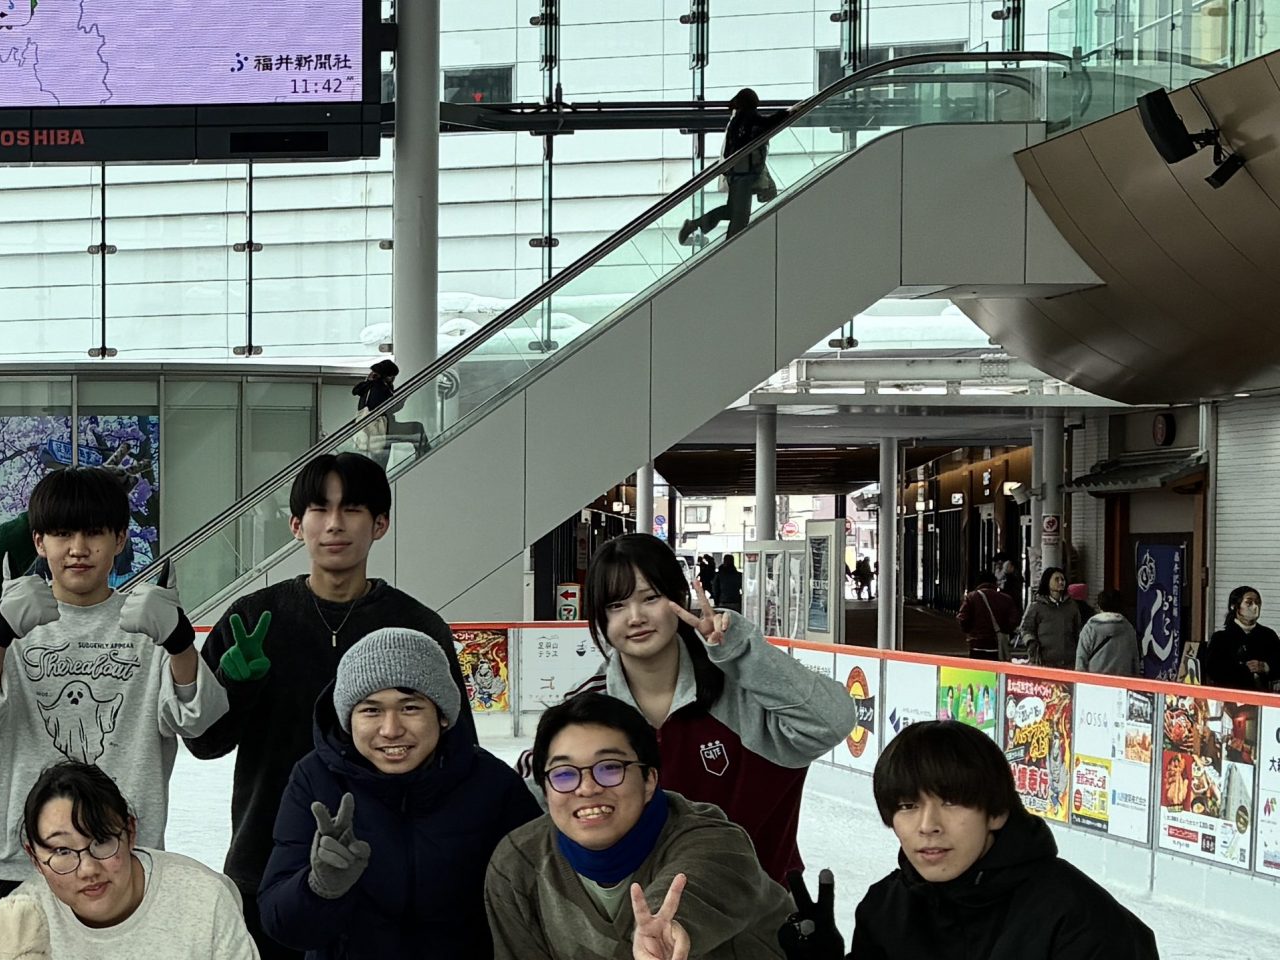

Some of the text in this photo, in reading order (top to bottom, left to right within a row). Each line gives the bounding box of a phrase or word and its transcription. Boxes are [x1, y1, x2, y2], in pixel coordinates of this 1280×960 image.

[253, 54, 352, 71] 福井新聞社
[290, 78, 342, 93] 11:42
[23, 641, 141, 682] Thereabout
